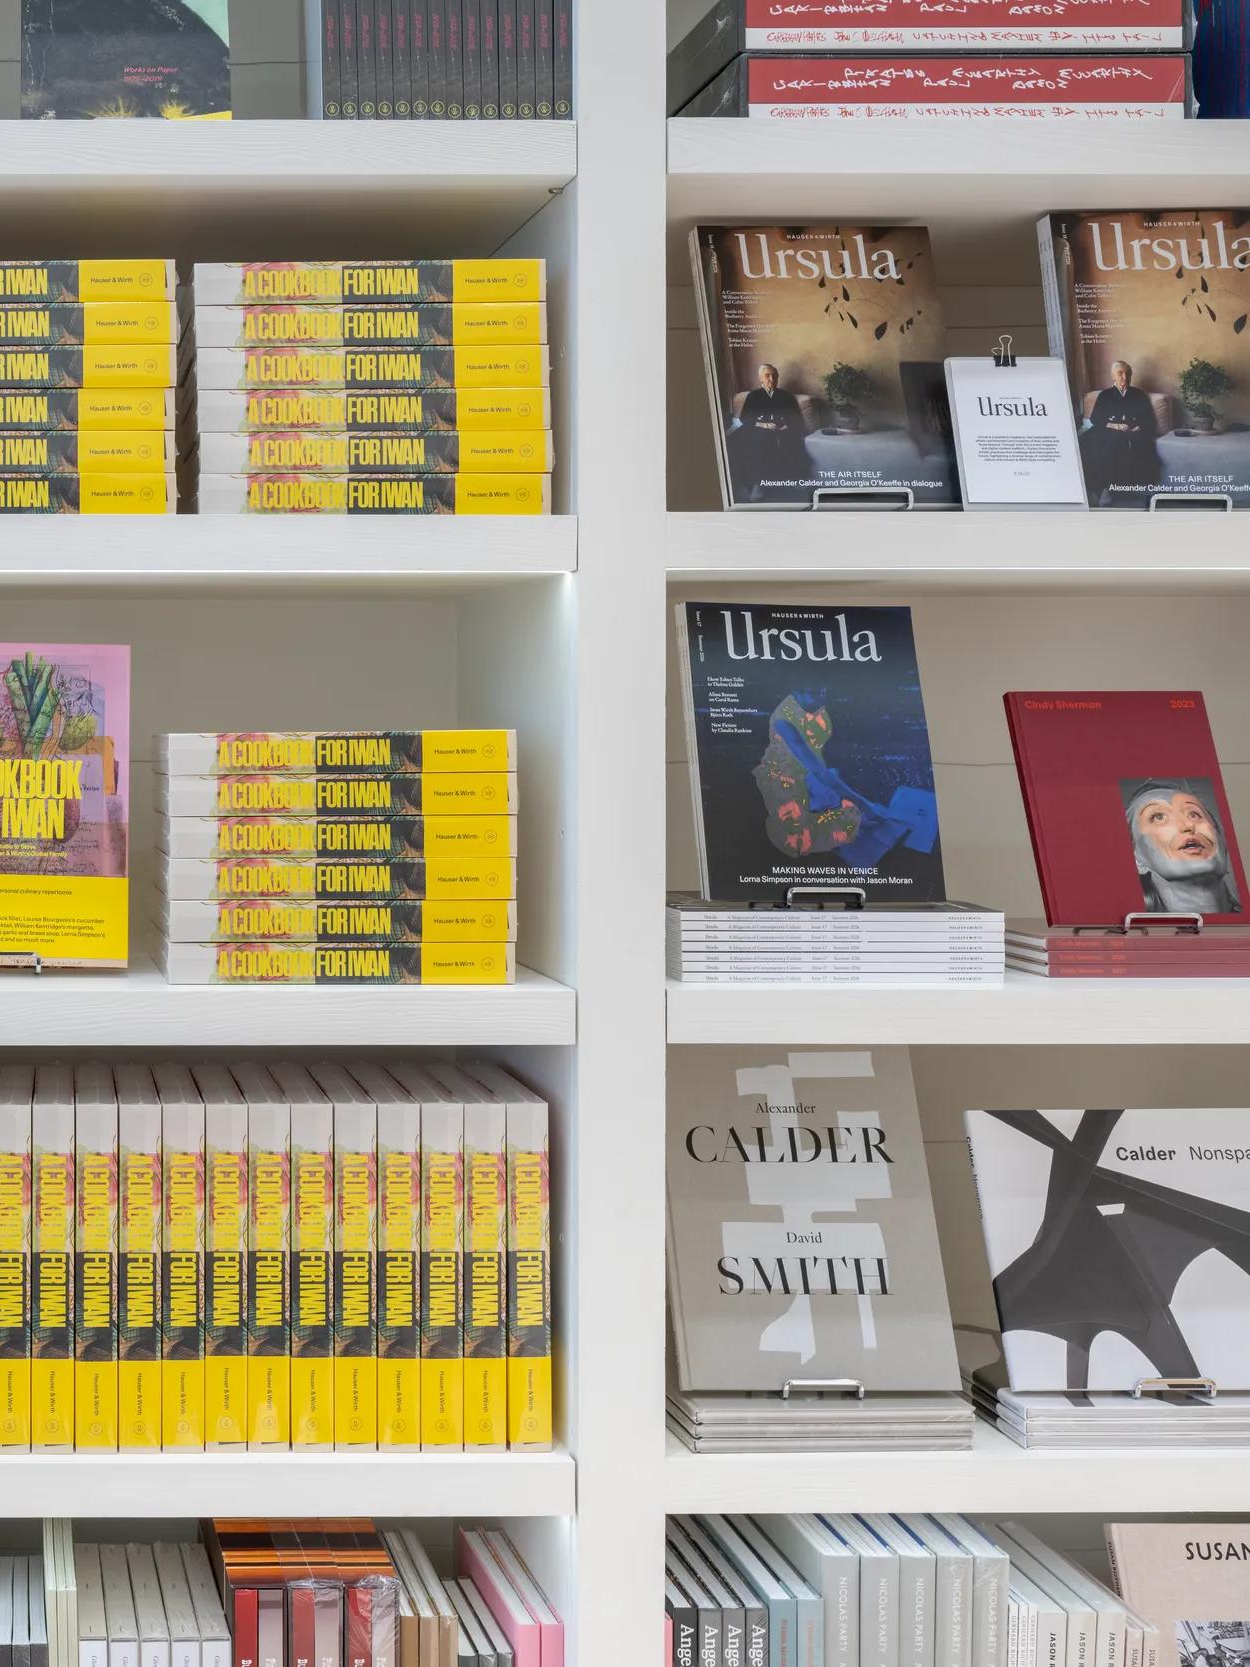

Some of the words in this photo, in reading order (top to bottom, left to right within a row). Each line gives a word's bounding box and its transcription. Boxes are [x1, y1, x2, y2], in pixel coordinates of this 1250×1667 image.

[734, 233, 903, 280] Ursula
[1087, 220, 1250, 271] Ursula
[248, 398, 258, 424] A
[261, 397, 346, 424] COOKBOOK
[347, 397, 378, 423] FOR
[379, 396, 422, 423] IWAN
[976, 396, 1048, 416] Ursula
[760, 479, 798, 487] Alexander
[799, 479, 823, 487] Calder
[825, 479, 839, 487] and
[840, 479, 869, 488] Georgia
[903, 479, 910, 487] in
[911, 479, 943, 488] dialogue
[1109, 484, 1146, 492] Alexander
[1148, 484, 1173, 492] Calder
[1174, 484, 1188, 492] and
[1190, 484, 1220, 493] Georgia
[1169, 475, 1186, 483] THE
[1188, 475, 1203, 483] AIR
[1204, 475, 1234, 483] ITSELF
[720, 610, 882, 662] Ursula
[1025, 700, 1054, 712] Cindy
[1055, 700, 1102, 710] Sherman
[1170, 700, 1196, 710] 2023
[1, 798, 65, 840] IWAN
[219, 824, 229, 850] A
[234, 824, 316, 850] COOKBOOK
[317, 824, 347, 850] FOR
[349, 824, 391, 850] IWAN
[762, 876, 792, 884] Simpson
[802, 876, 849, 884] conversation
[850, 876, 866, 884] with
[866, 876, 888, 884] Jason
[888, 876, 913, 884] Moran
[772, 867, 806, 875] MAKING
[807, 867, 836, 875] WAVES
[837, 867, 847, 875] IN
[848, 867, 879, 875] VENICE
[755, 1102, 816, 1114] Alexander
[685, 1125, 896, 1164] CALDER
[1115, 1146, 1177, 1161] Calder
[786, 1232, 823, 1244] David
[517, 1252, 543, 1283] FOR
[716, 1256, 895, 1296] SMITH
[517, 1284, 543, 1326] IWAN
[1185, 1542, 1250, 1561] SUSAN
[878, 1577, 887, 1622] NICOLAS
[677, 1624, 695, 1667] Ange
[878, 1624, 887, 1654] PARTY
[1049, 1633, 1058, 1660] JASON
